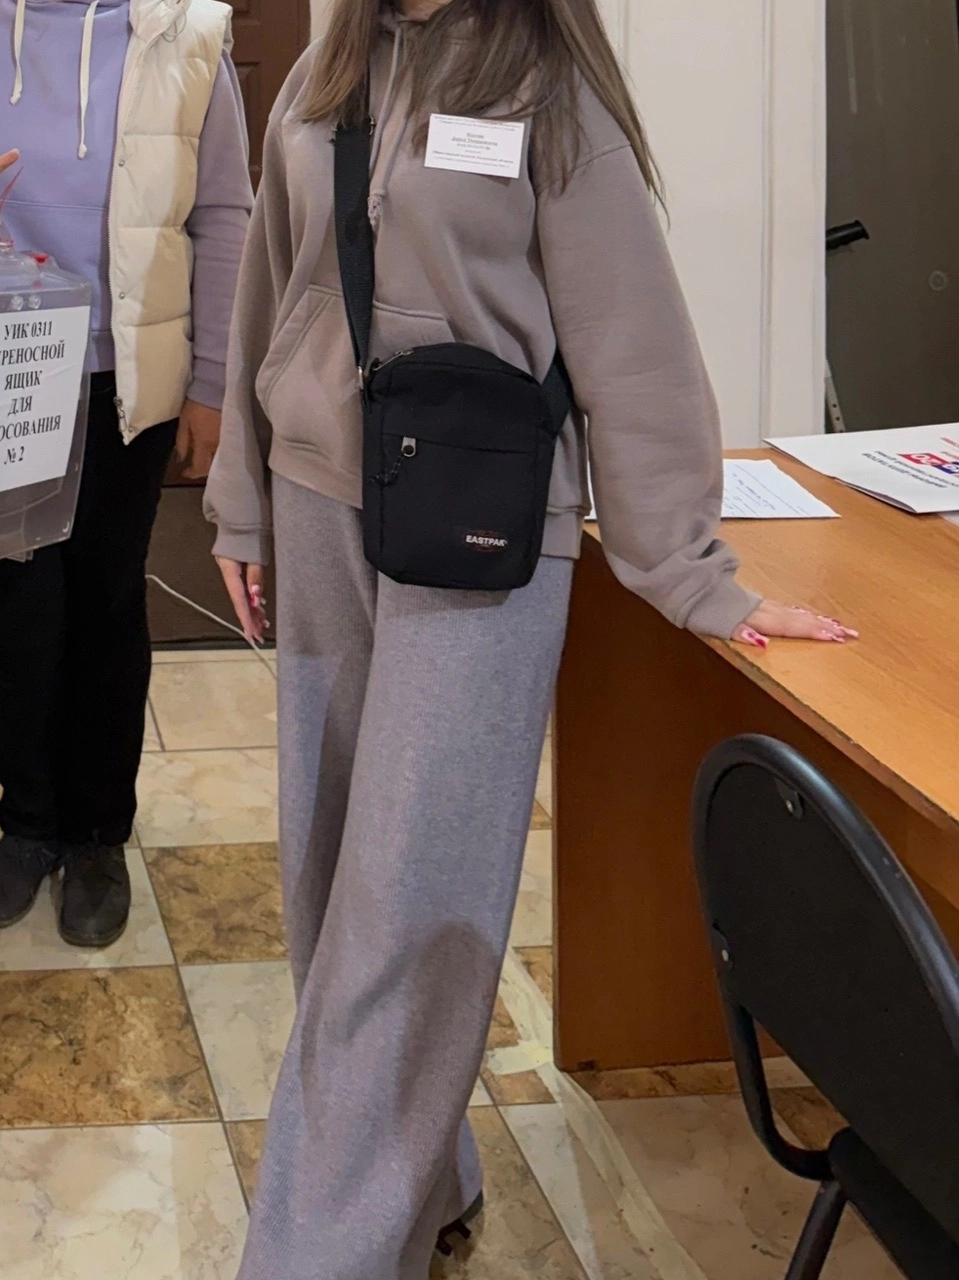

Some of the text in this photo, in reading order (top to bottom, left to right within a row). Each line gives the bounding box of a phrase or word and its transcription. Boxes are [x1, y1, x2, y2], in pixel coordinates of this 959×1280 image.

[4, 320, 53, 341] УИК 0311
[3, 370, 43, 391] ЯЩИК
[7, 395, 33, 416] ДЛЯ
[3, 446, 25, 465] № 2
[465, 534, 505, 547] EASTPAK
